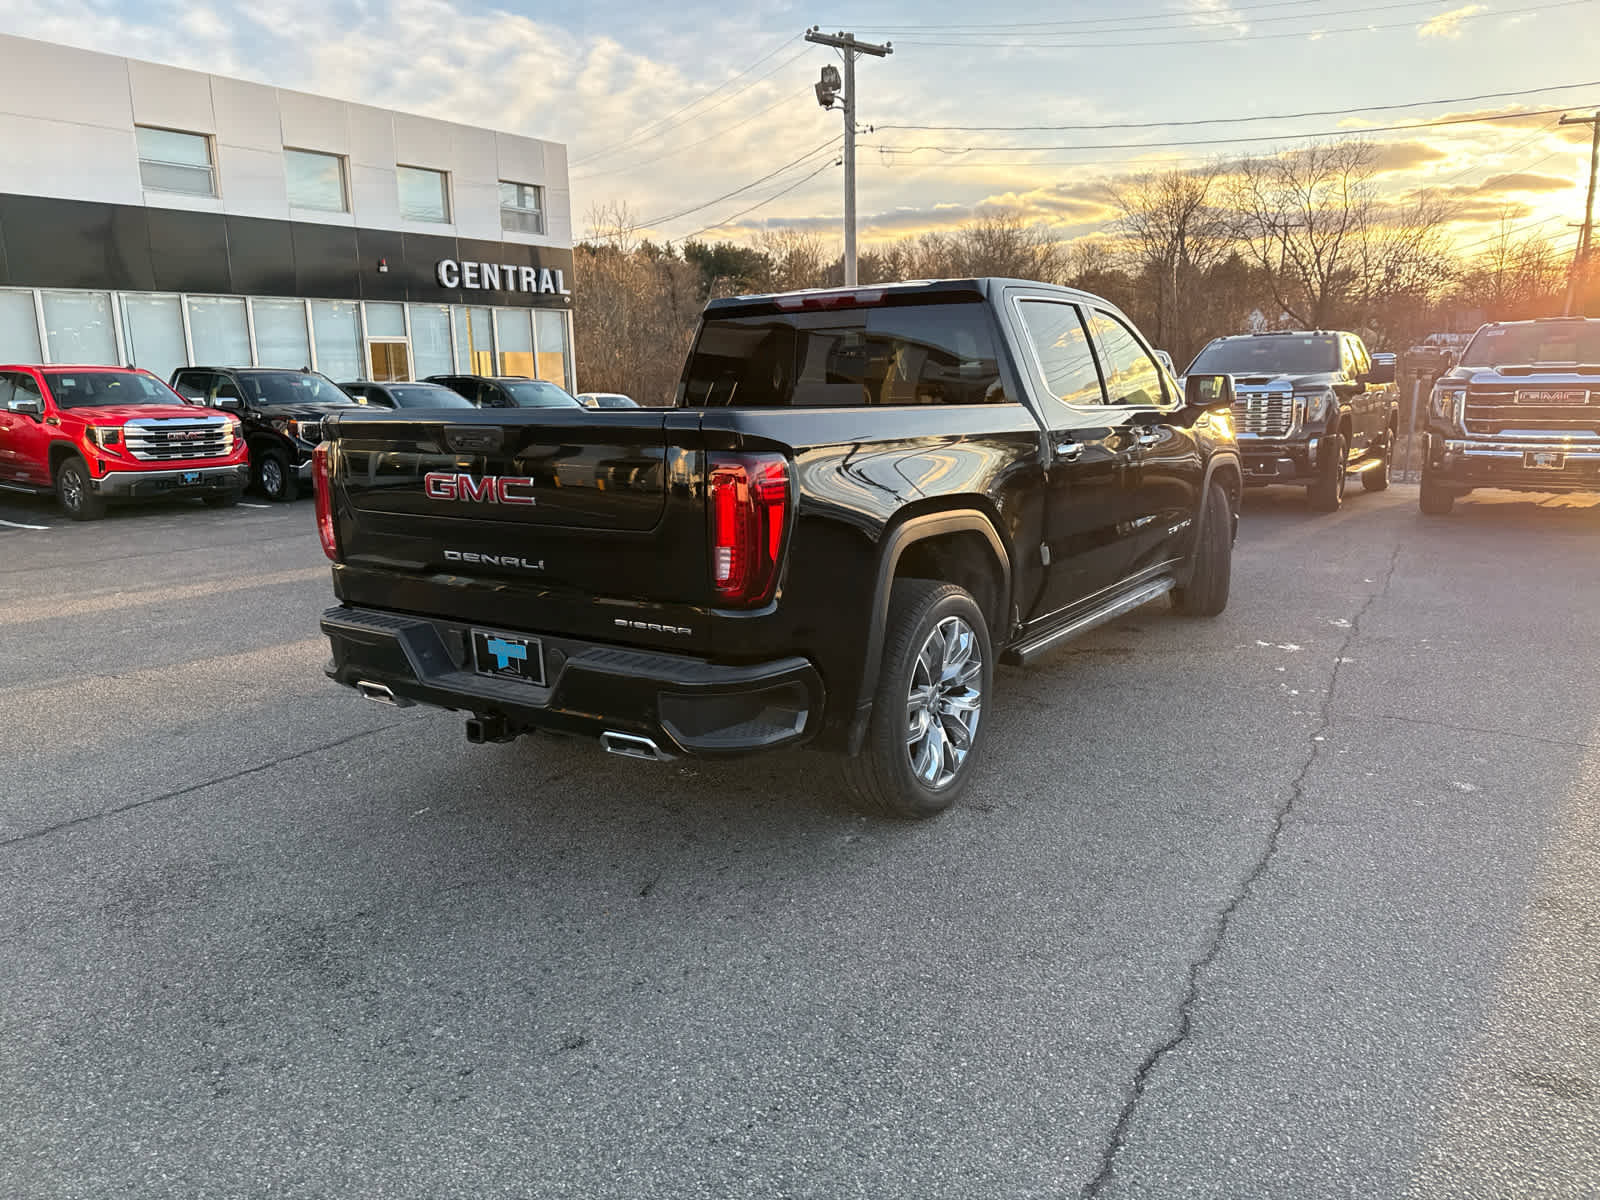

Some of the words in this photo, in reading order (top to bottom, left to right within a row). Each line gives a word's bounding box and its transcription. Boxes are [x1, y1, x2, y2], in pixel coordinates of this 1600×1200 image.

[438, 259, 571, 295] CENTRAL
[424, 472, 536, 505] GMC
[443, 550, 545, 570] DENALI
[614, 618, 692, 635] SIERRA
